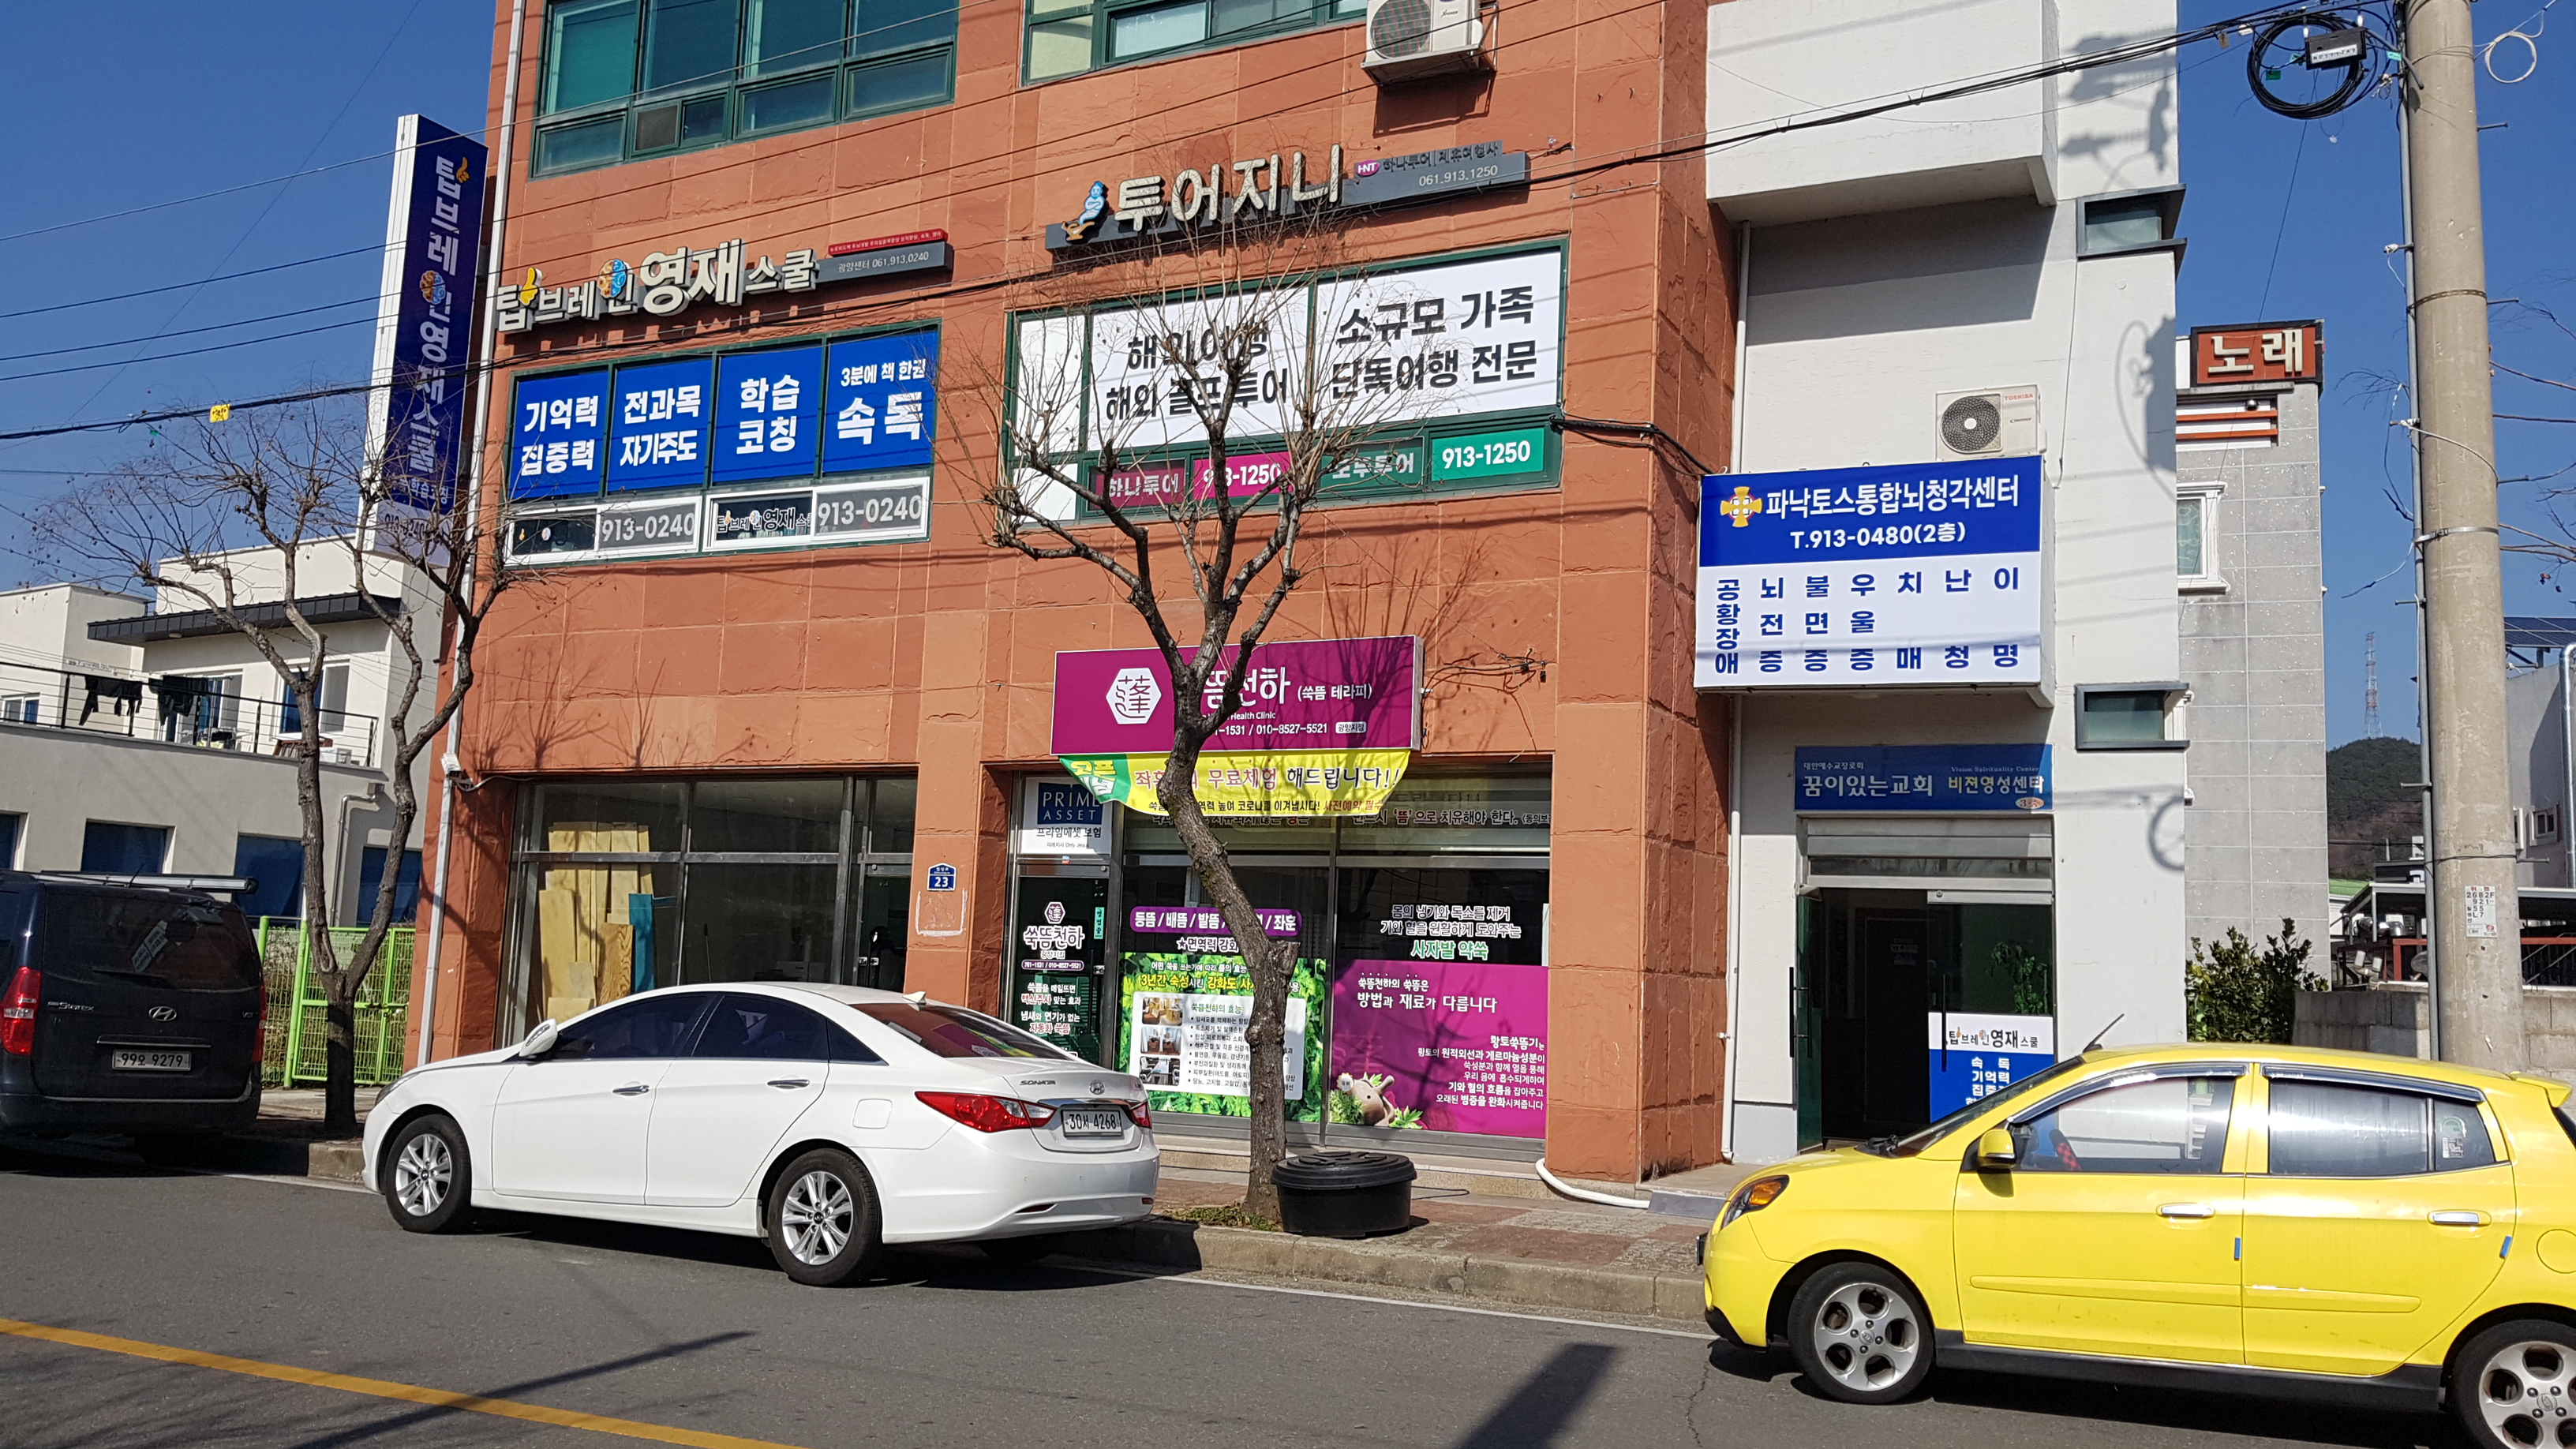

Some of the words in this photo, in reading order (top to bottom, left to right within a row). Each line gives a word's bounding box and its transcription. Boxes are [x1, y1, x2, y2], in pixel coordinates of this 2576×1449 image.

[1357, 163, 1377, 174] HNT
[1419, 165, 1499, 187] 061.913.1250
[1114, 143, 1343, 231] 투어지니
[838, 260, 870, 273] 광양센터
[872, 251, 930, 268] 061.913.0240
[1336, 298, 1448, 349] 소규모
[1460, 285, 1534, 329] 가족
[2208, 328, 2304, 374] 노래
[841, 363, 878, 388] 3분에
[881, 361, 895, 382] 책
[898, 358, 927, 380] 한권
[1332, 349, 1459, 400] 단독여행
[1472, 339, 1537, 385] 전문
[624, 384, 701, 425] 전과목
[740, 374, 800, 414] 학습
[1106, 384, 1158, 421] 해외
[524, 395, 599, 432] 기억력
[837, 391, 924, 445] 속독
[736, 416, 797, 455] 코칭
[521, 439, 595, 477] 집중력
[620, 429, 698, 466] 자기주도
[1442, 440, 1531, 470] 913-1250
[1109, 471, 1180, 498] 하나투어
[1203, 463, 1282, 488] 93-1250
[1765, 474, 2020, 520] 파낙토스통합뇌청각센터
[818, 494, 923, 526] 913-0240
[601, 512, 695, 542] 913-0240
[1790, 522, 1967, 550] T.913-0480(2층)
[1204, 666, 1291, 710] 뜸천하
[1297, 685, 1327, 702] (쑥뜸
[1331, 683, 1373, 700] 테라피)
[1256, 711, 1277, 721] Clinic
[1256, 723, 1328, 735] 010-8527-5521
[1337, 723, 1365, 733] 광양지점
[1208, 769, 1277, 791] 무료체험
[1286, 766, 1400, 791] 해드립니다!!
[1948, 776, 2045, 796] 비젼영성센터
[1043, 809, 1096, 821] ASSET
[1218, 800, 1235, 811] 높여
[1274, 799, 1321, 811] 이겨냅시다!
[1324, 799, 1364, 812] 사전예약
[1440, 810, 1487, 825] 치유해야
[1491, 810, 1518, 825] 한다.
[1036, 826, 1081, 838] 프라임에셋
[1084, 826, 1102, 838] 보험
[934, 876, 949, 888] 23
[1166, 912, 1188, 929] 배뜸
[1197, 912, 1220, 929] 발뜸
[1273, 915, 1297, 931] 좌훈
[1392, 904, 1413, 919] 몸의
[1416, 904, 1450, 920] 냉기와
[1451, 905, 1485, 921] 독소를
[1486, 906, 1511, 922] 제거
[1023, 925, 1086, 950] 쑥뜸천하
[1380, 920, 1403, 936] 기와
[1405, 920, 1428, 936] 혈을
[1428, 921, 1473, 938] 원활하게
[1475, 923, 1522, 939] 도와주는
[1186, 937, 1218, 953] 면역력
[1410, 939, 1456, 960] 사자발
[1458, 941, 1489, 961] 약쑥
[1140, 974, 1167, 987] 3년간
[1170, 974, 1204, 988] 숙성시킨
[1207, 975, 1238, 990] 강화도
[1357, 976, 1400, 990] 쑥뜸천하의
[1403, 977, 1429, 992] 쑥뜸은
[58, 1002, 95, 1012] Starex
[1357, 991, 1394, 1009] 방법과
[1399, 993, 1437, 1011] 재료가
[1442, 995, 1498, 1013] 다릅니다
[1020, 1010, 1042, 1021] 냄새와
[1044, 1011, 1066, 1022] 연기가
[1068, 1013, 1081, 1023] 없는
[1490, 1035, 1545, 1051] 황토쑥뜸기는
[120, 1052, 146, 1066] 99오
[151, 1053, 184, 1068] 9279
[1441, 1048, 1485, 1061] 원적외선과
[1463, 1071, 1479, 1081] 우리
[1971, 1069, 2010, 1084] 기억력
[1436, 1094, 1459, 1105] 오래된
[1448, 1081, 1466, 1093] 기와
[1513, 1086, 1544, 1098] 잡아주고
[1093, 1113, 1117, 1130] 4268
